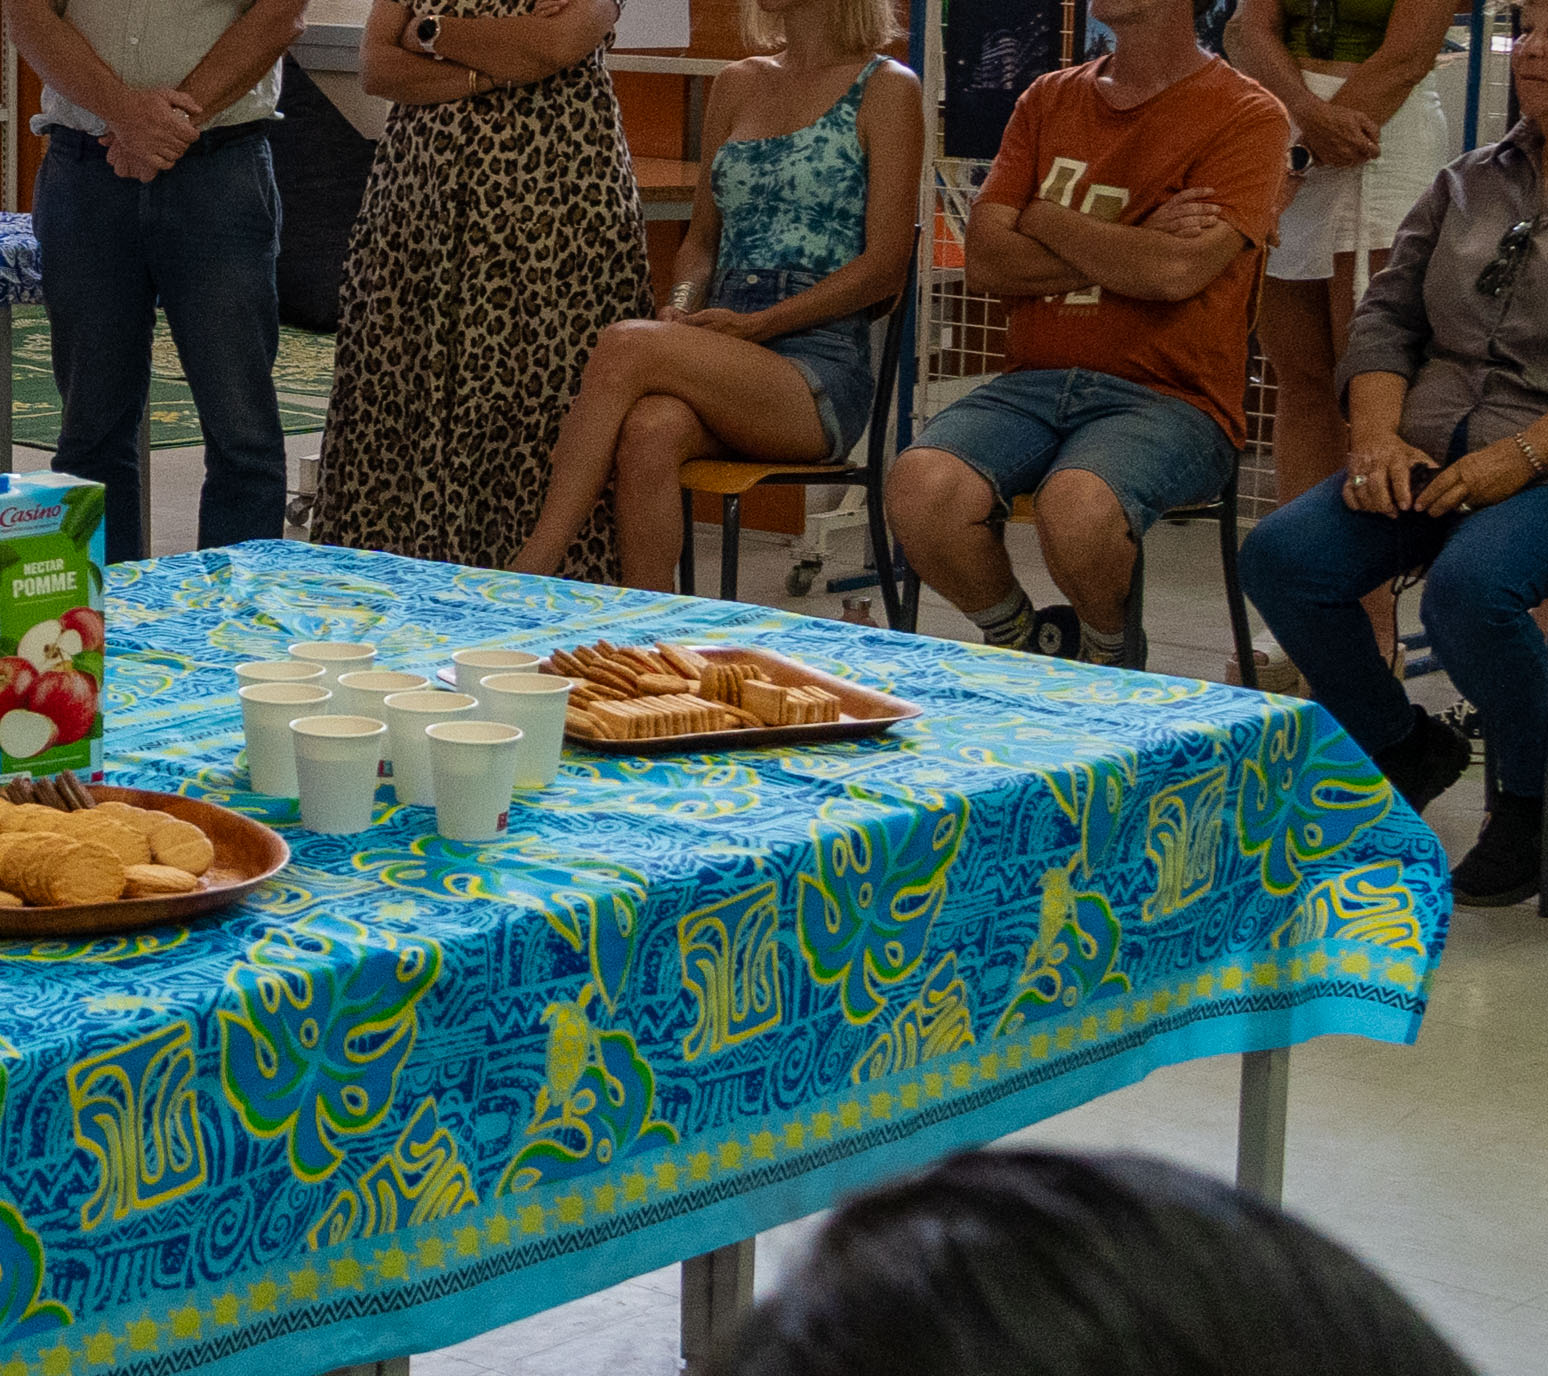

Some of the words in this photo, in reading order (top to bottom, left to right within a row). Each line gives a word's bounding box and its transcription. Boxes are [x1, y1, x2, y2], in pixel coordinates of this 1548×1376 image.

[0, 504, 62, 528] Casino
[23, 558, 64, 576] NECTAR
[12, 571, 78, 599] POMME
